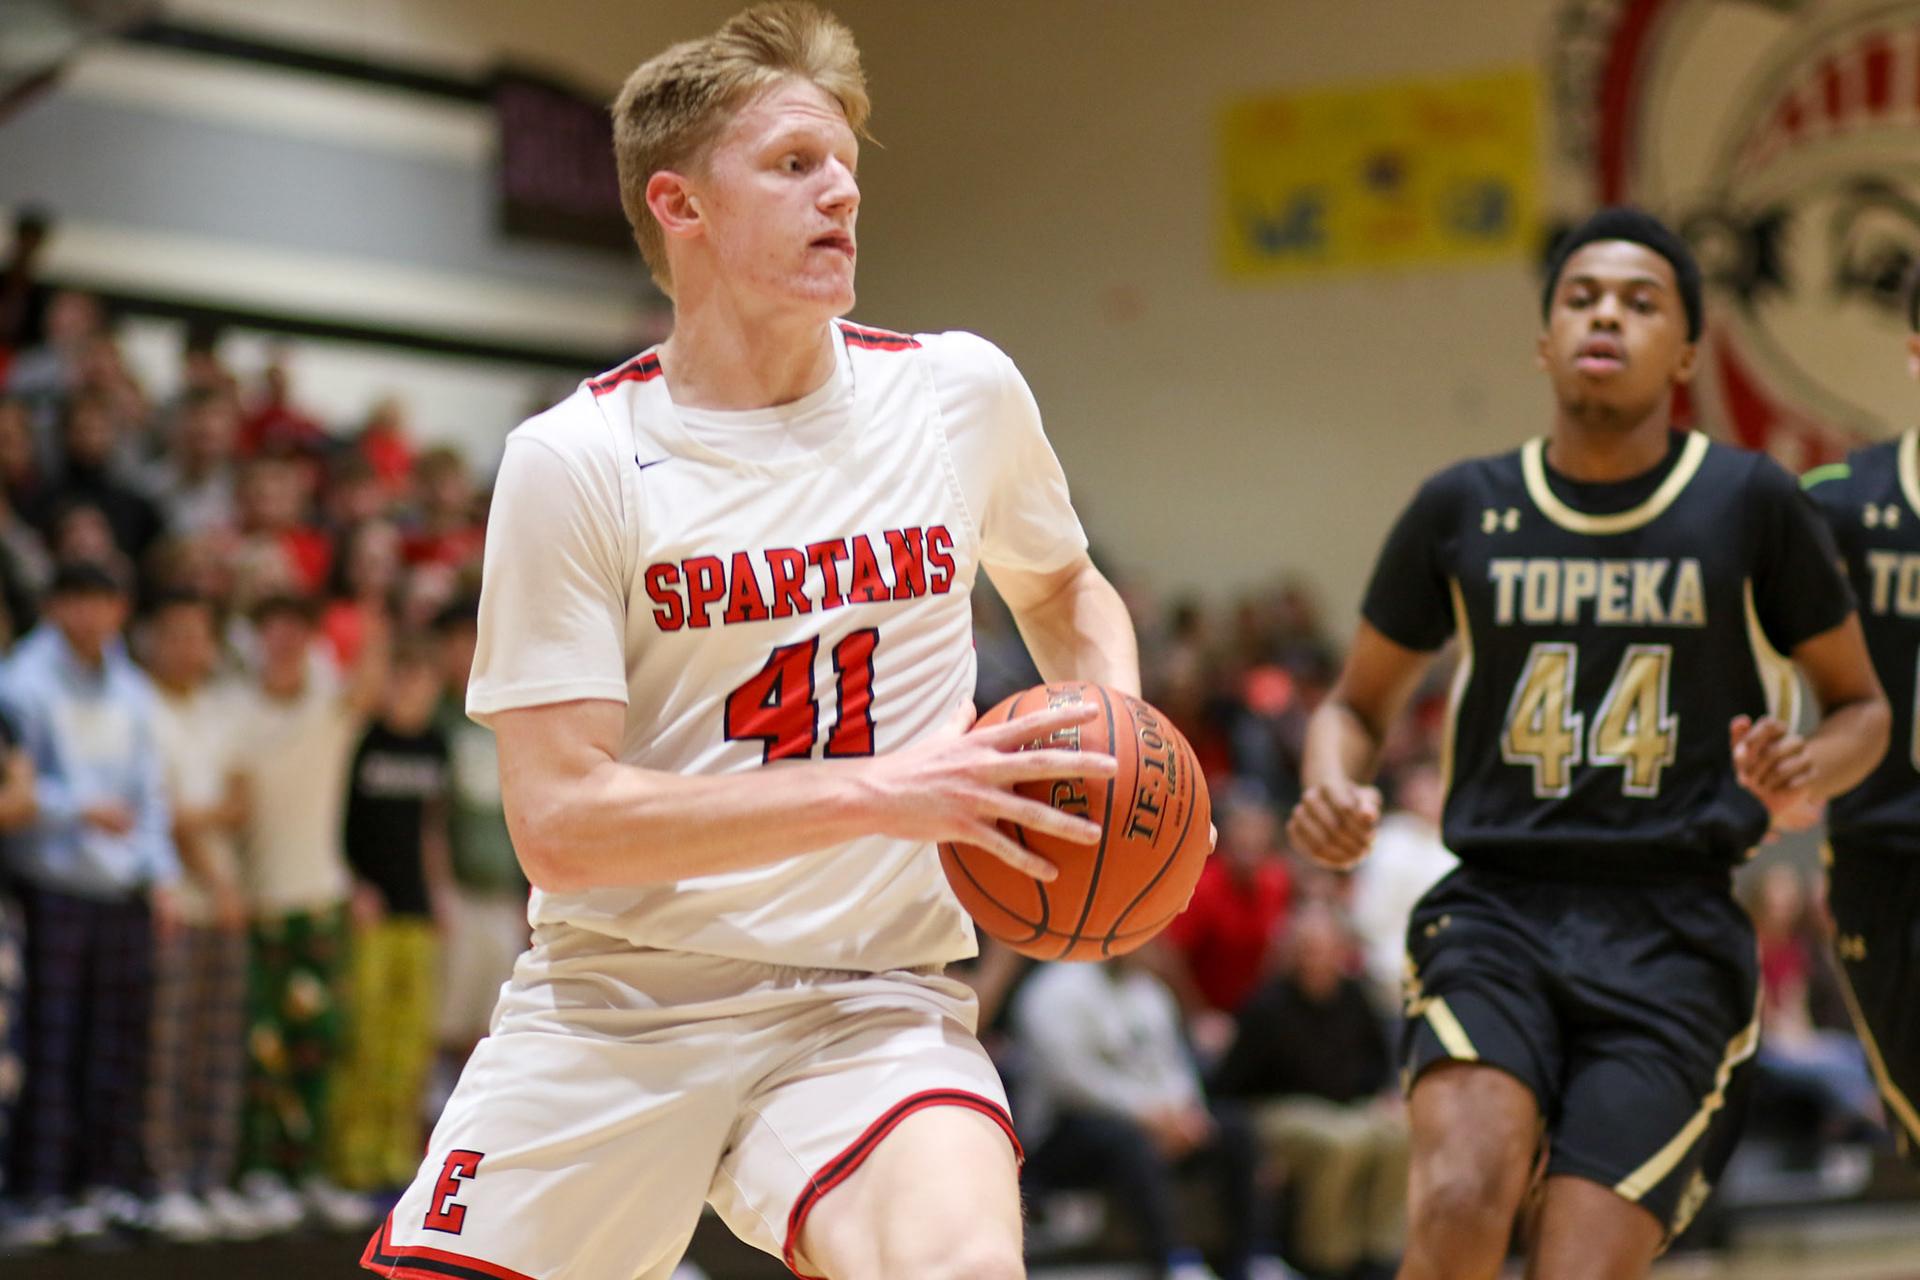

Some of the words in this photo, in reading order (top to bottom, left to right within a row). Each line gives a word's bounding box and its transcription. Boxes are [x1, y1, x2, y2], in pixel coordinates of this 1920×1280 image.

[645, 525, 955, 632] SPARTANS
[1488, 557, 1707, 627] TOPEKA
[724, 627, 879, 765] 41
[1501, 642, 1679, 798] 44
[422, 1149, 485, 1235] E
